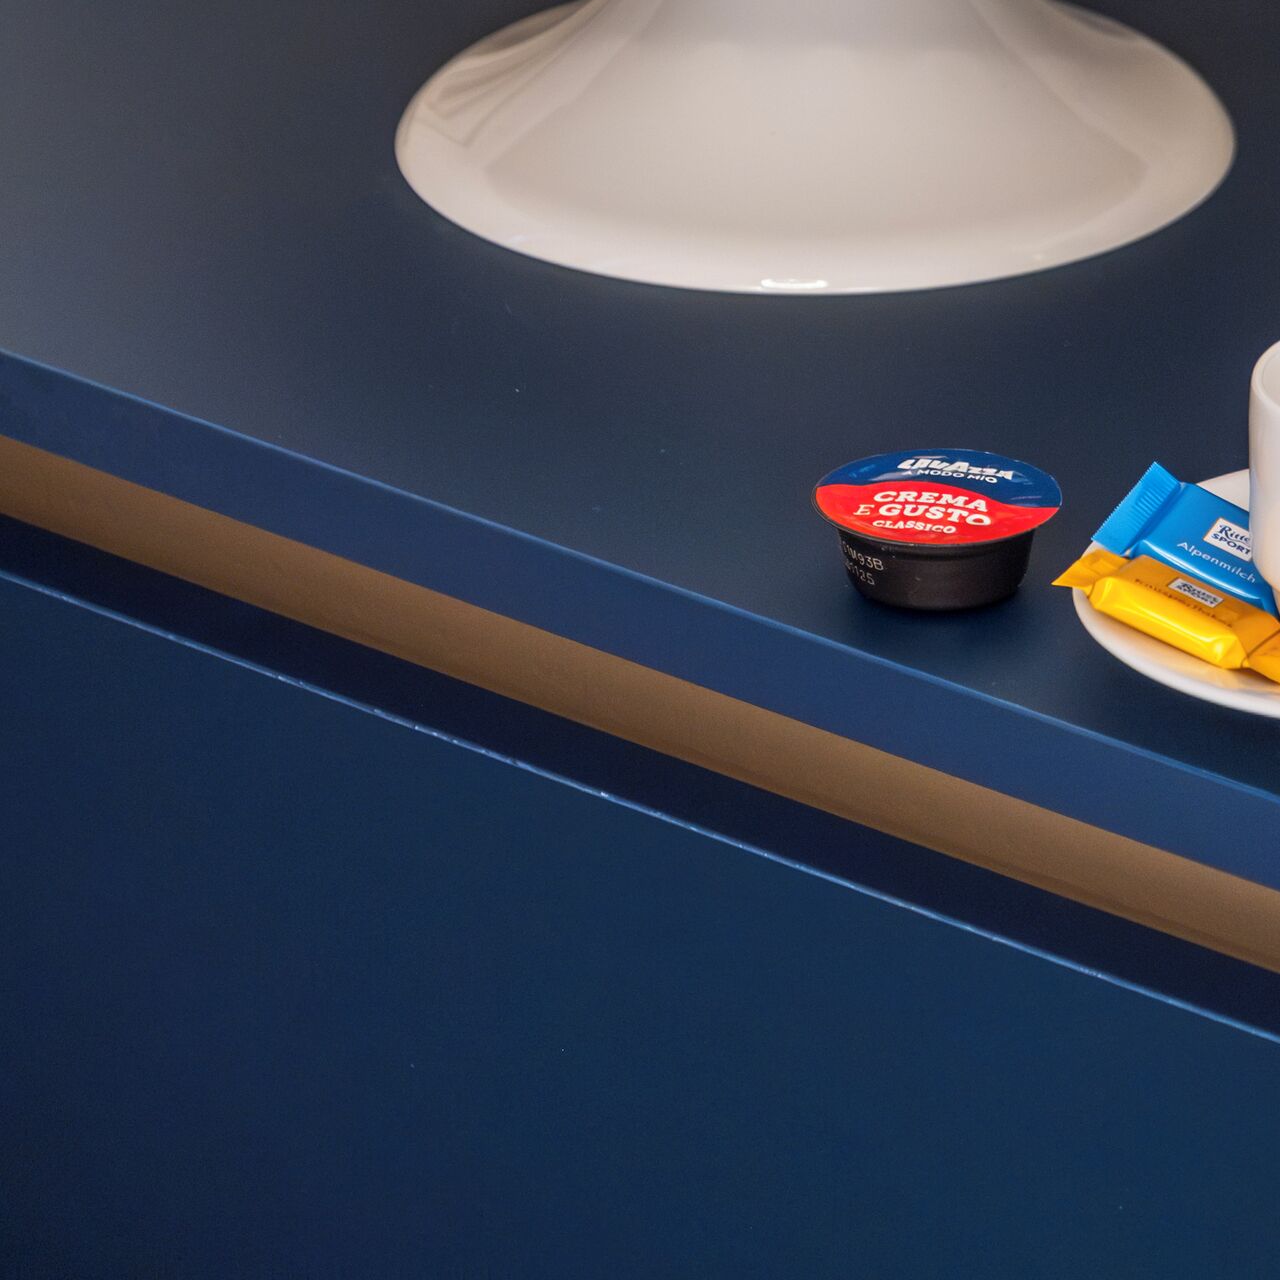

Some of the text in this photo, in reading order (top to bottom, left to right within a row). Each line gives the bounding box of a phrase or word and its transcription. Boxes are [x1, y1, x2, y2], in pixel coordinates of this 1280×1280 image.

[916, 469, 965, 479] MODO
[966, 474, 998, 484] MIO
[872, 490, 989, 513] CREMA
[853, 503, 993, 527] E GUSTO
[871, 519, 958, 535] CLASSICO
[1211, 532, 1252, 556] SPORT
[1176, 541, 1257, 584] Alpenmilch
